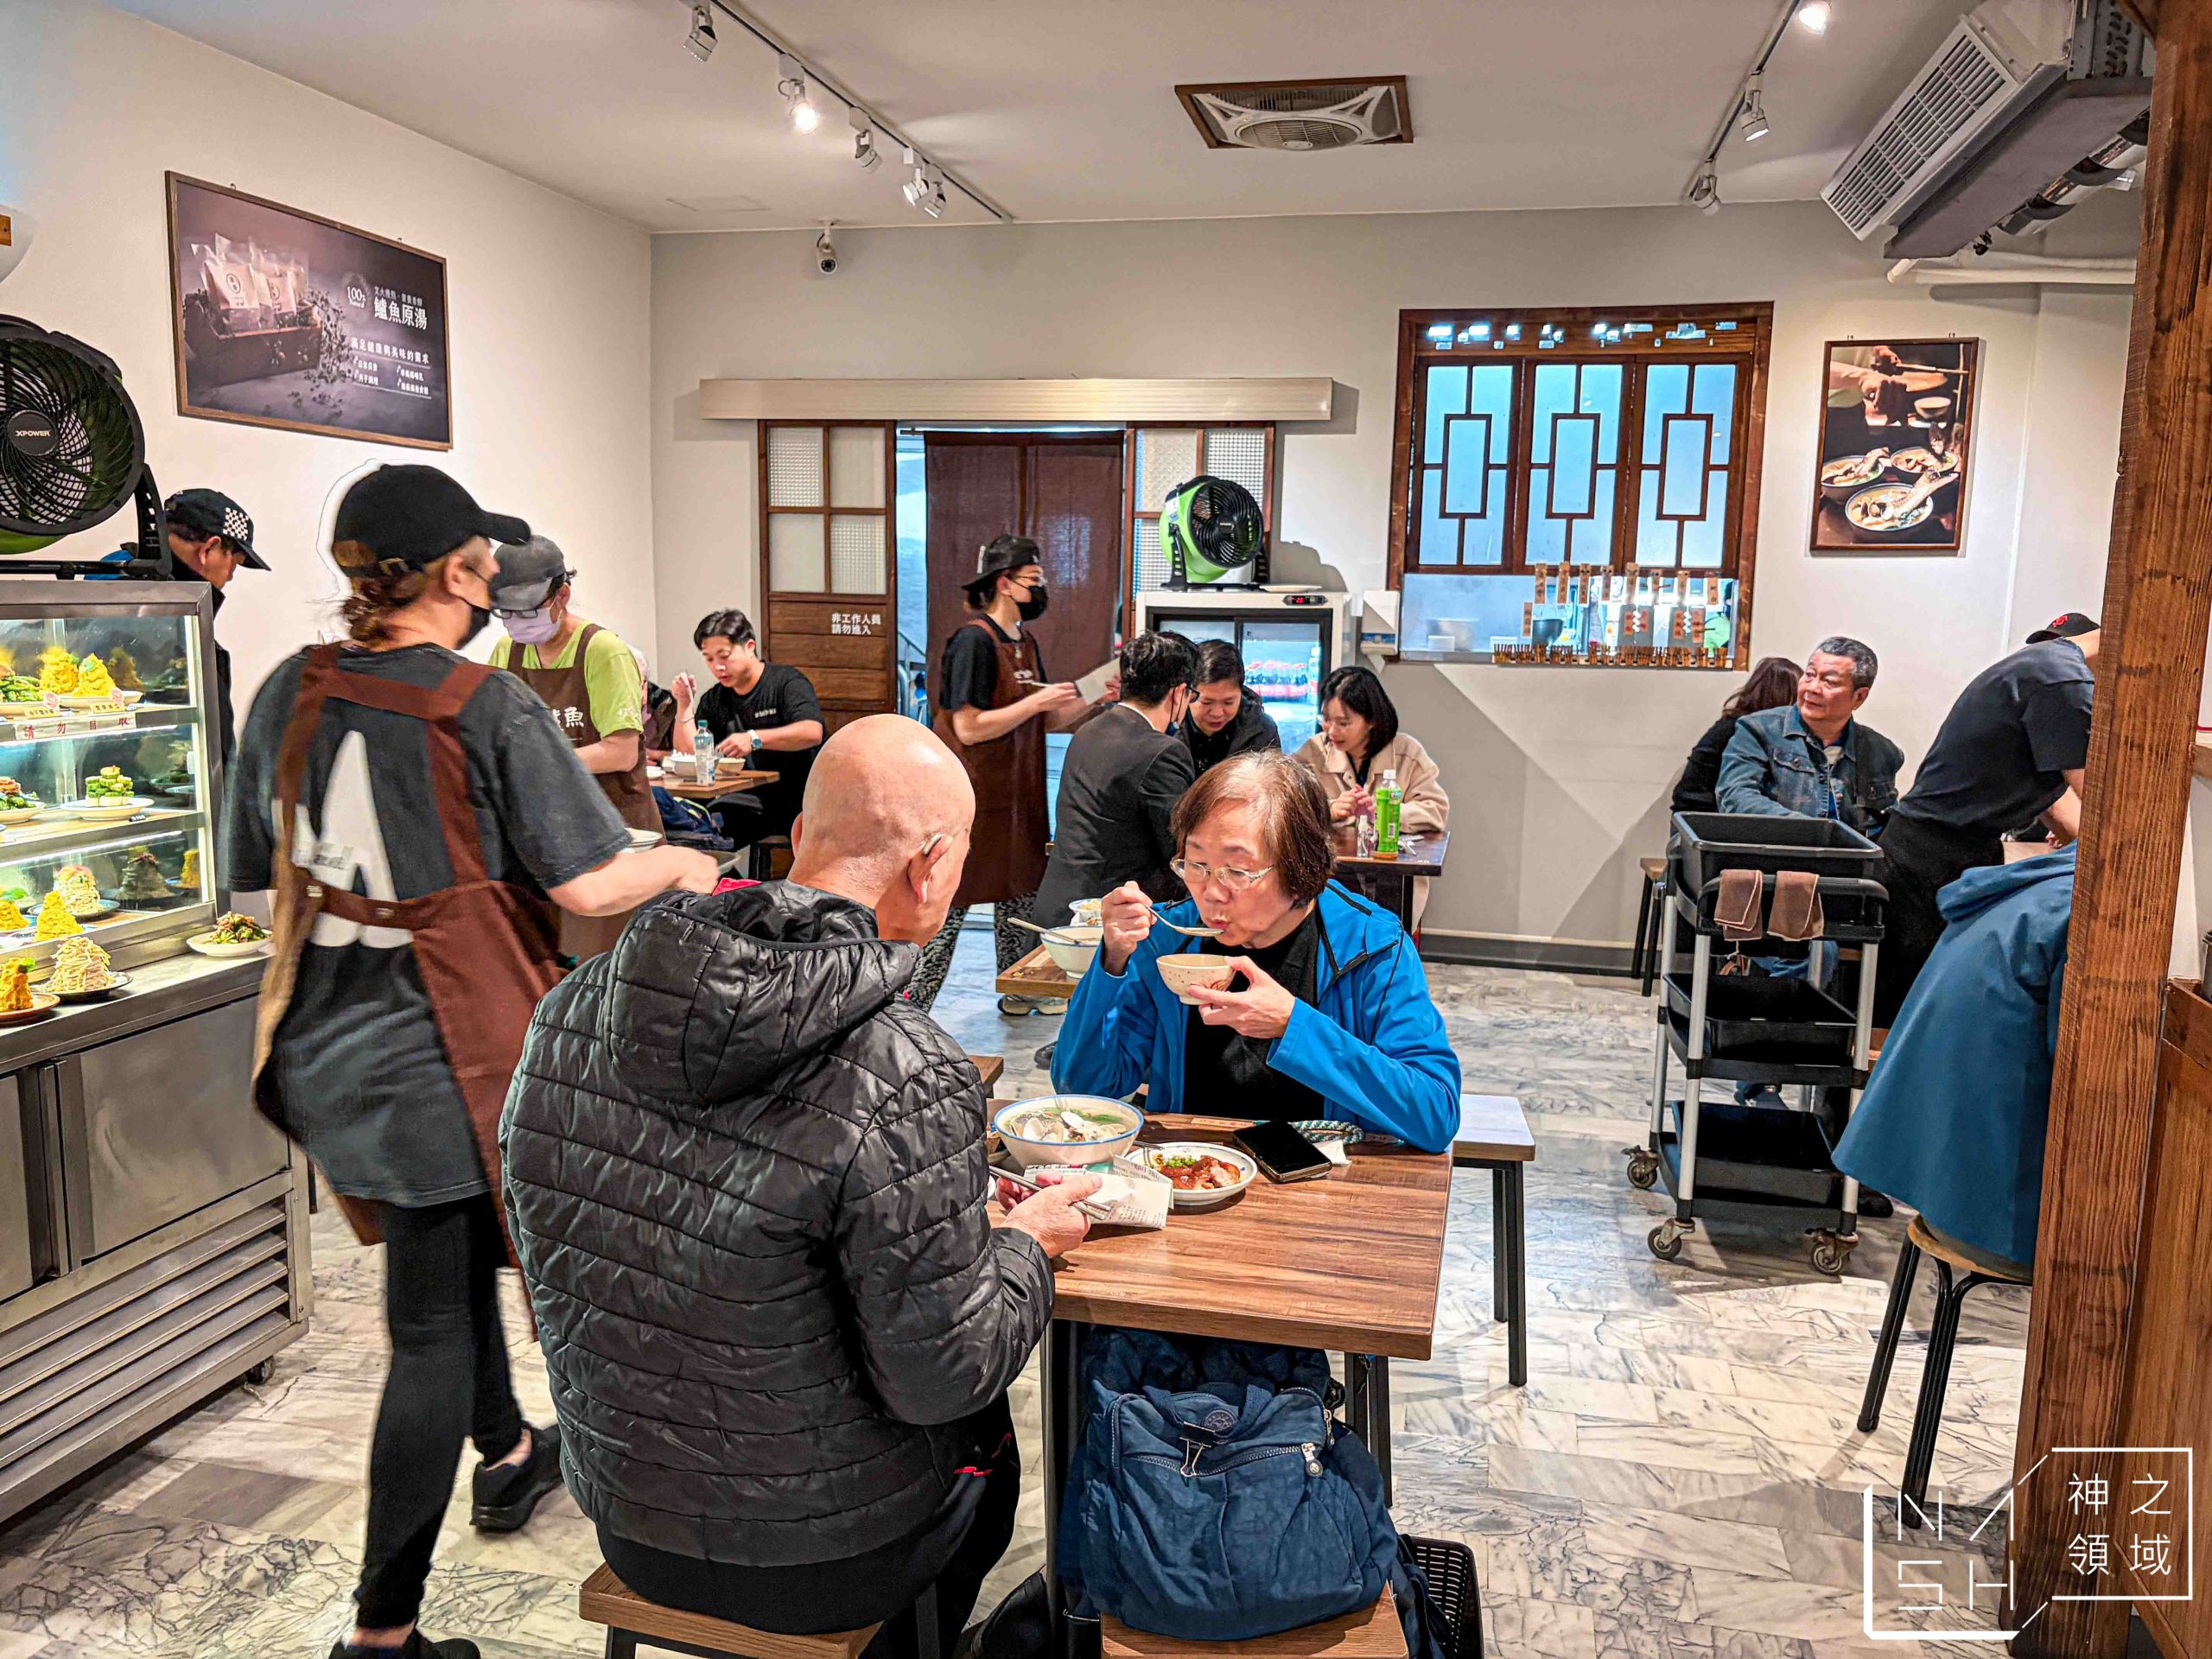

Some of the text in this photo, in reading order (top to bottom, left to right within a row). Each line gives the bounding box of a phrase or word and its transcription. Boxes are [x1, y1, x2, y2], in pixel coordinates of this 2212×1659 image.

[373, 296, 428, 330] 鱸魚原湯
[831, 613, 881, 625] 非工作人員
[831, 623, 872, 635] 請勿進入
